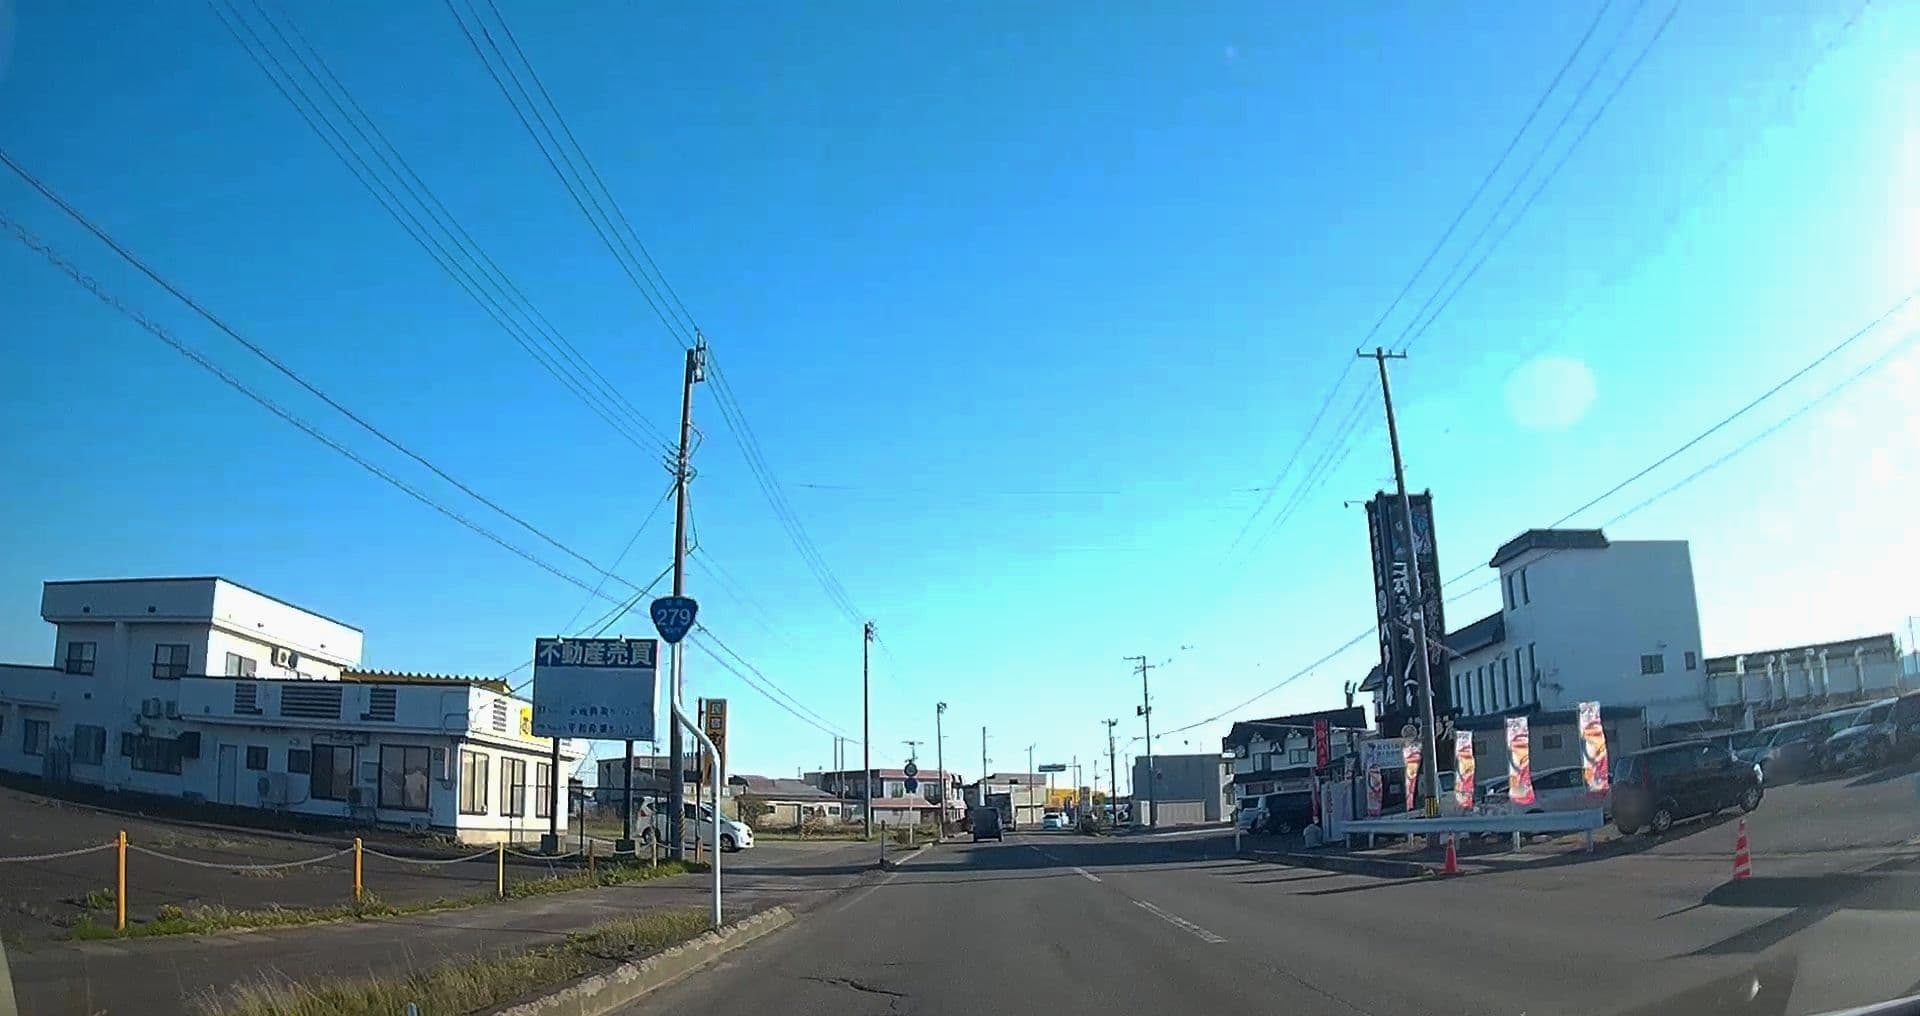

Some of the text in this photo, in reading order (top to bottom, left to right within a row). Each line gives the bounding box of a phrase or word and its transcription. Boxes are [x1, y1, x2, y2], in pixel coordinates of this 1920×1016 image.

[657, 608, 691, 625] 279
[540, 641, 652, 665] 不動産売買
